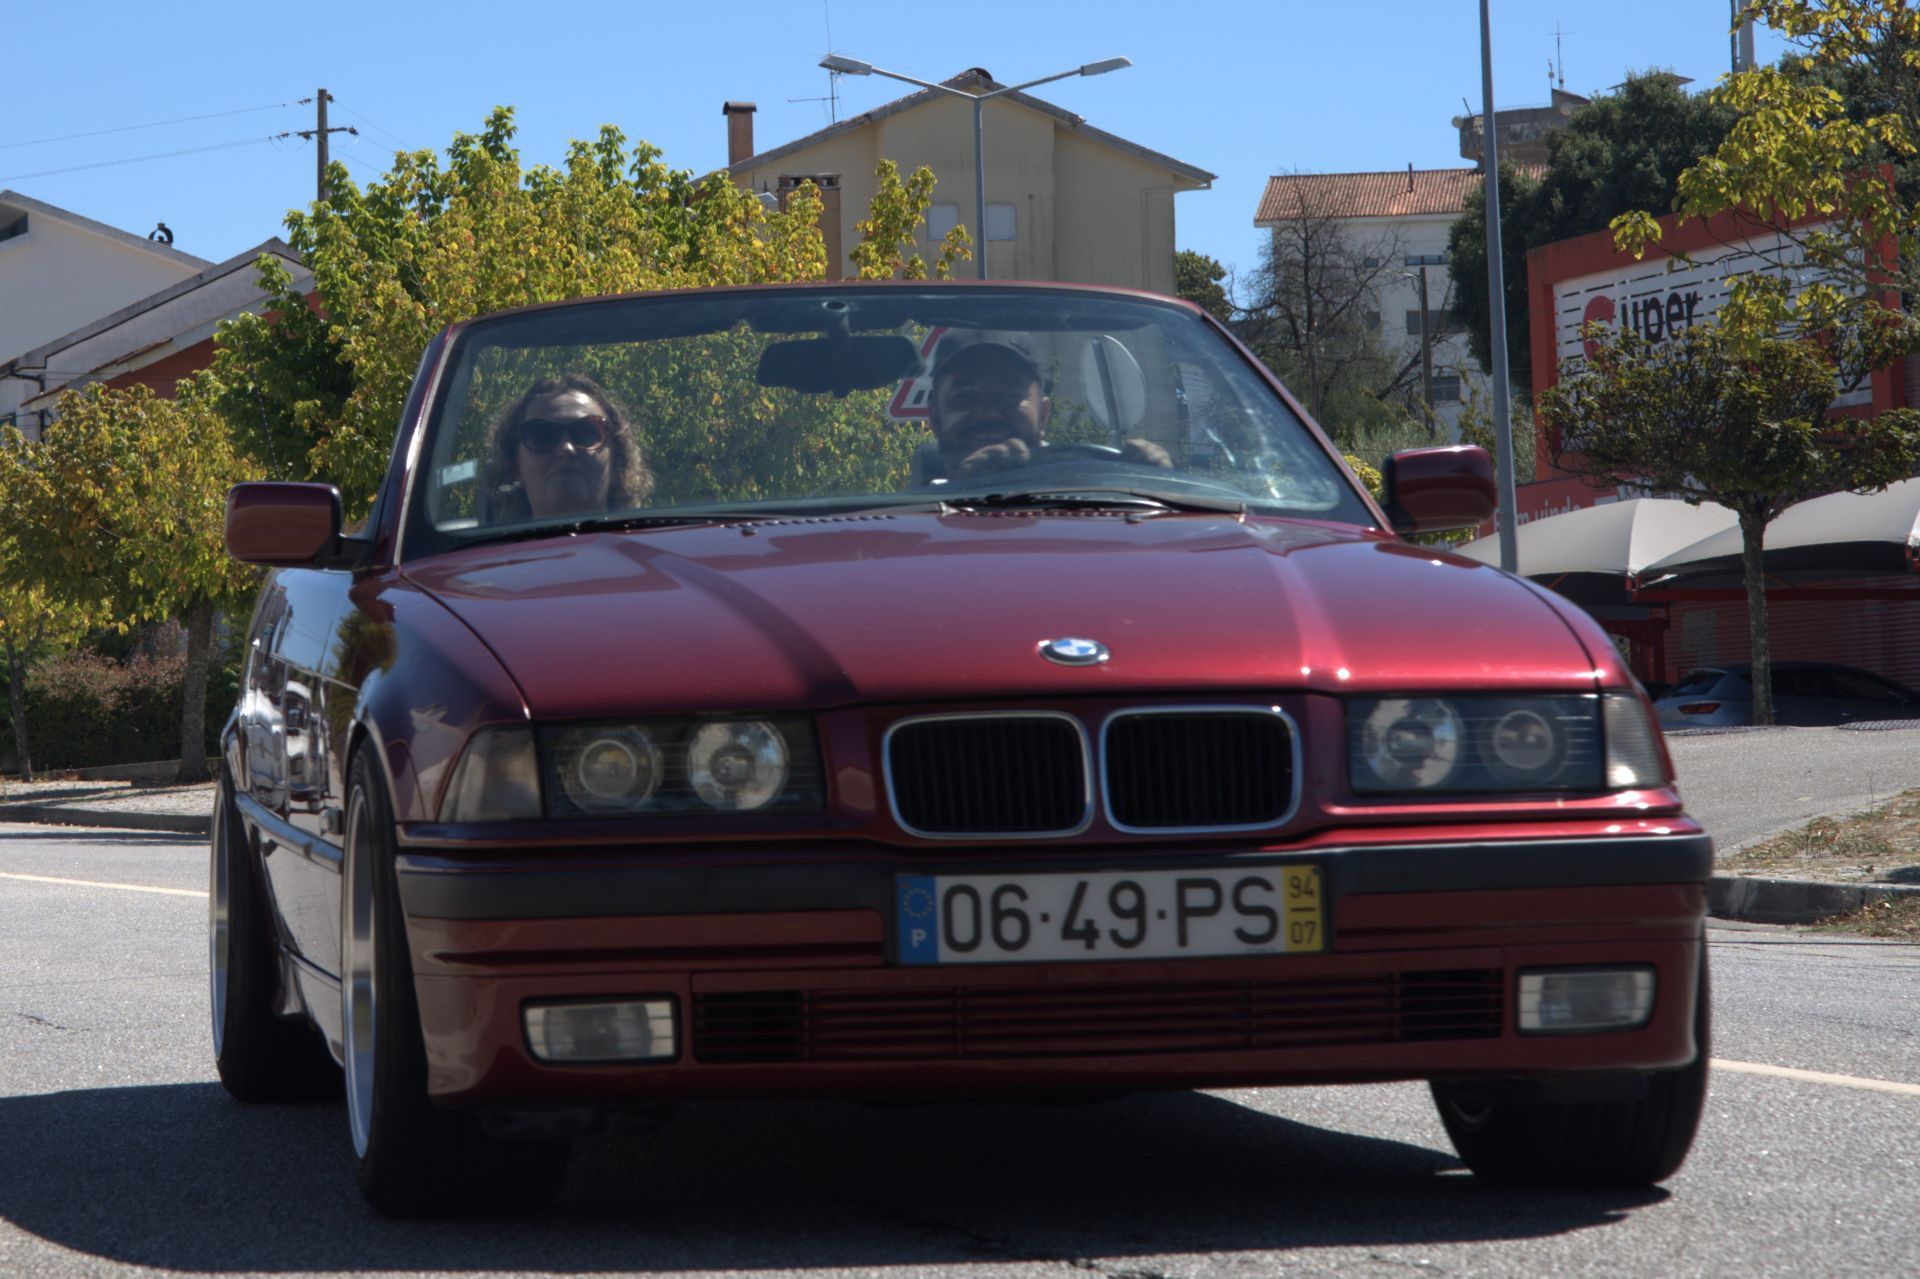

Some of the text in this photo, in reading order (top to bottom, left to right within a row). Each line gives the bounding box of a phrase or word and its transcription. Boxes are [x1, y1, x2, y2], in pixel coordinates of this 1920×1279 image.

[1289, 875, 1315, 898] 94
[911, 928, 927, 948] P
[1291, 921, 1316, 945] 07
